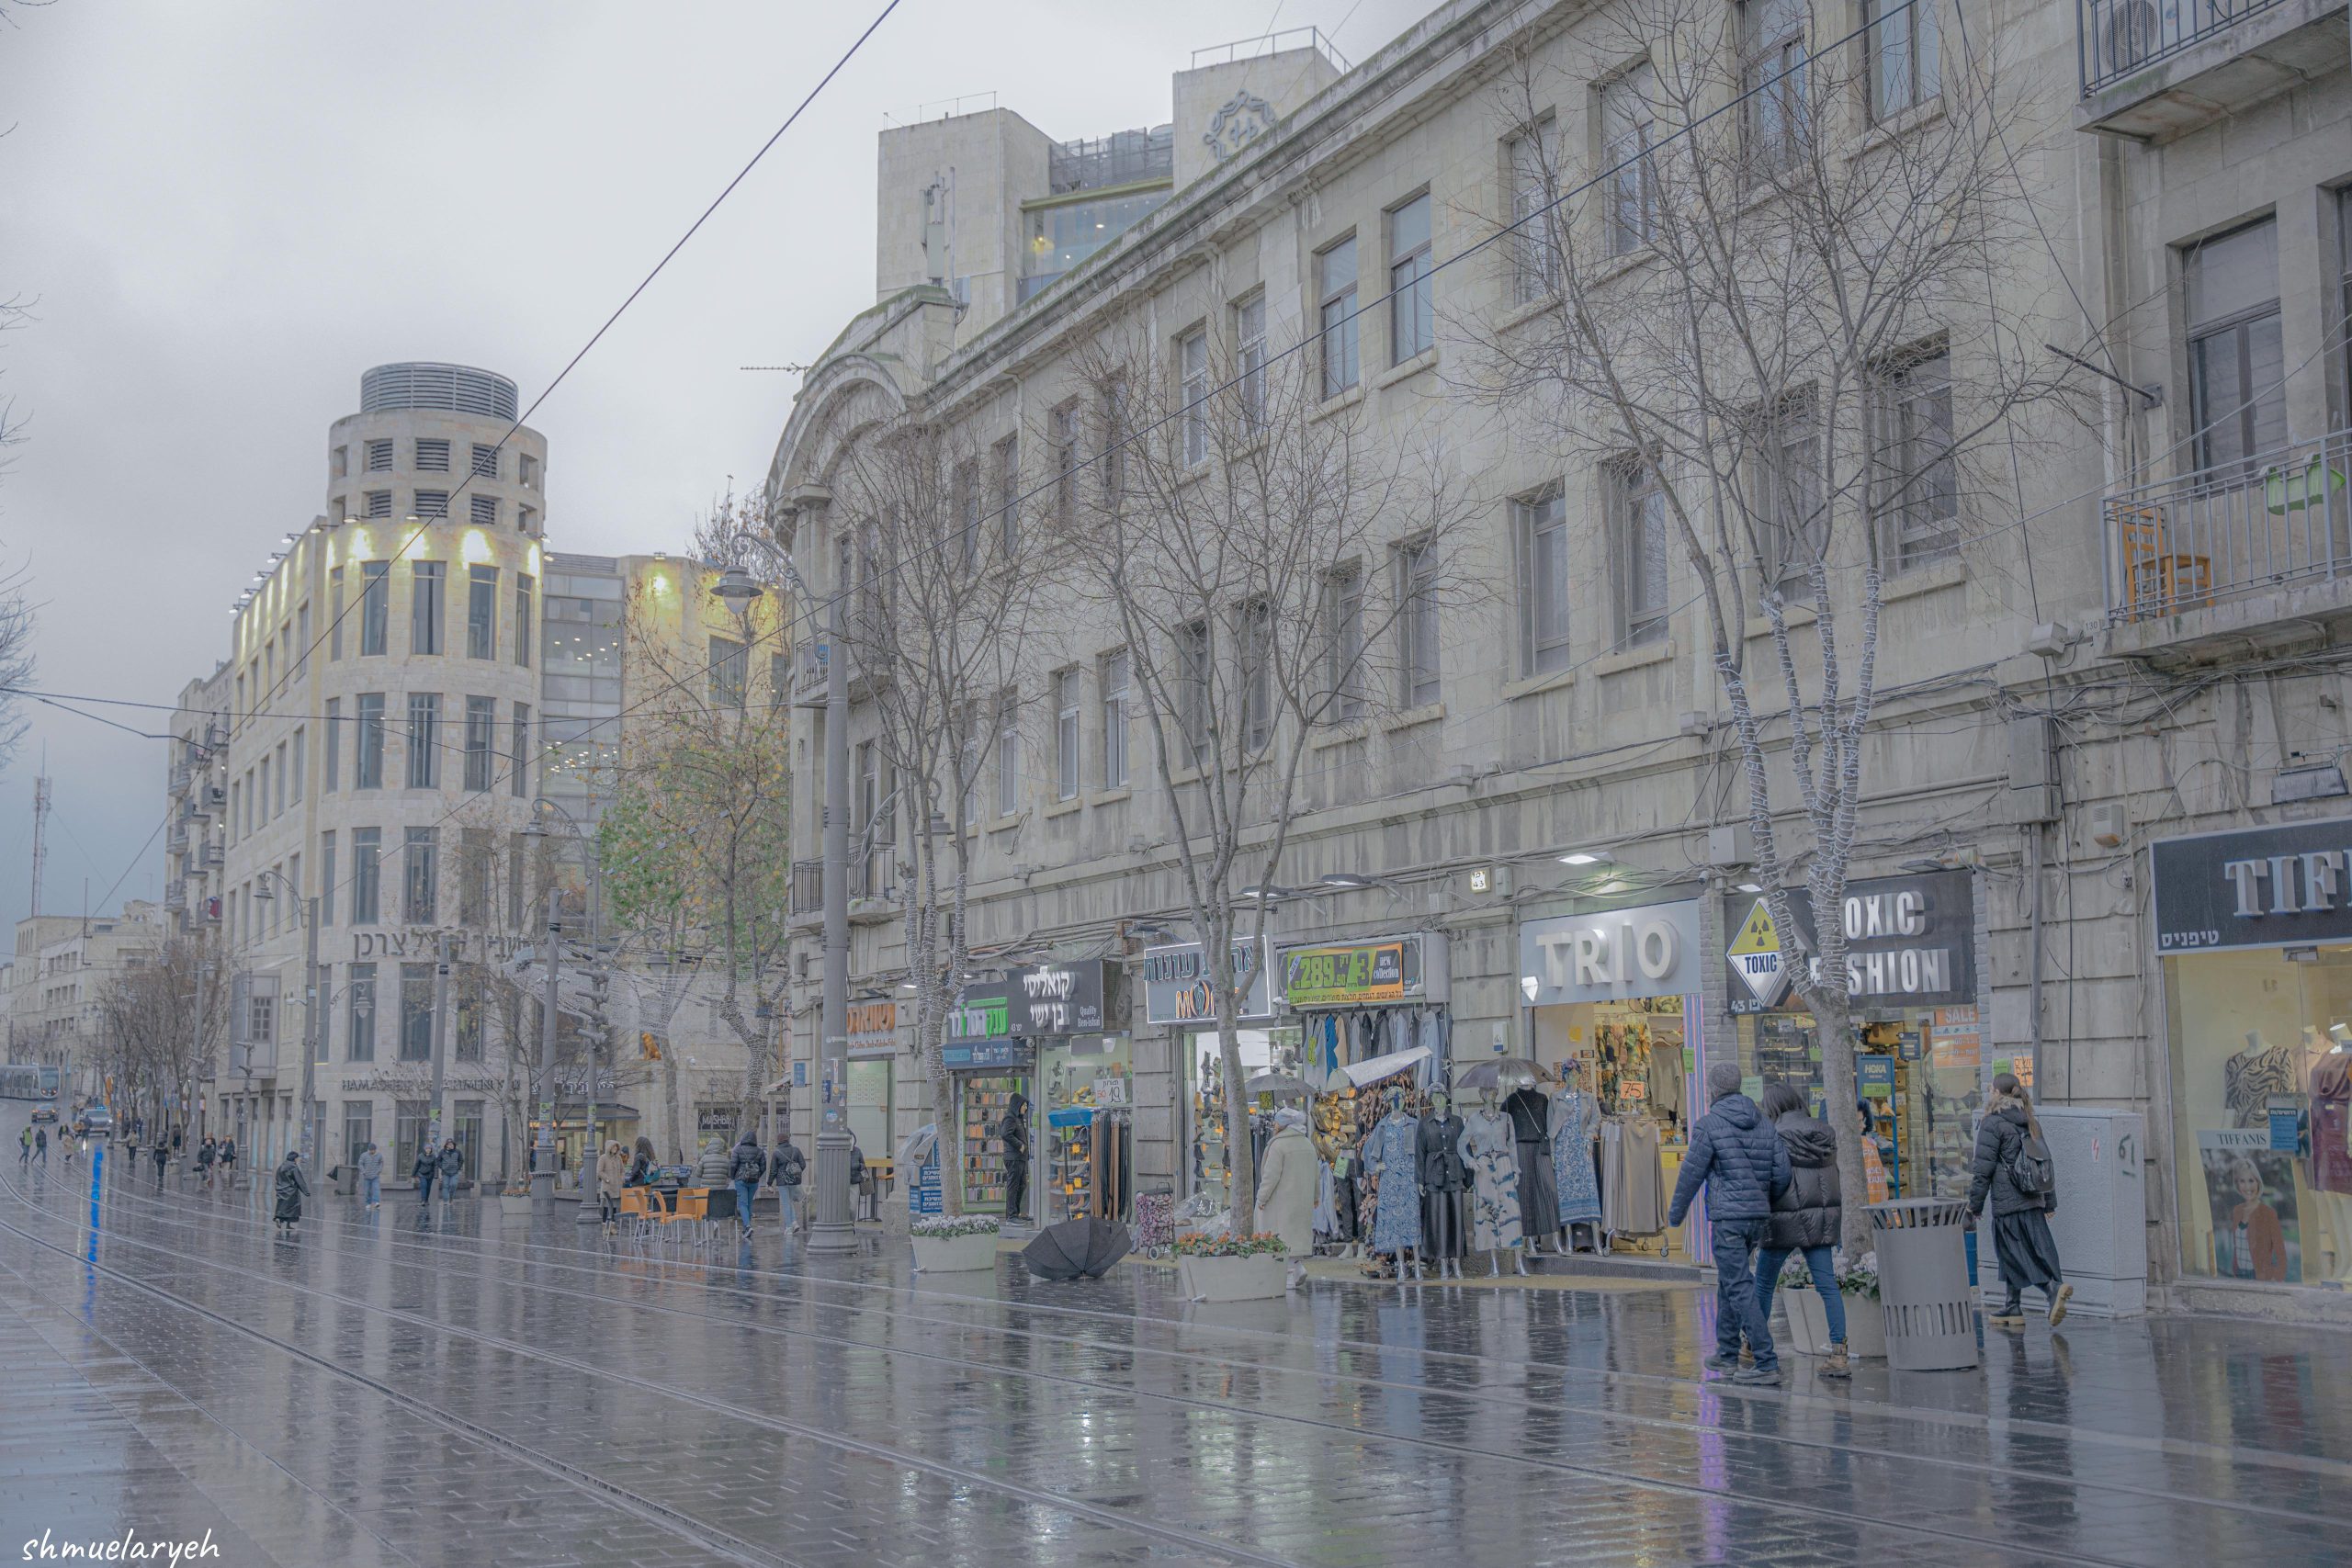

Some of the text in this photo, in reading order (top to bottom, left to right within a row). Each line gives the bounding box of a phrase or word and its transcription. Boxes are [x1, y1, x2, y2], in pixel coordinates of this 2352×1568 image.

[2224, 850, 2352, 917] TIF
[1845, 891, 1922, 941] OXIC
[2161, 930, 2220, 947] טיפניס
[1379, 955, 1391, 967] new
[1535, 920, 1679, 988] TRIO
[1143, 953, 1195, 982] עונות
[1745, 953, 1778, 974] TOXIC
[1373, 968, 1399, 980] collection
[1809, 949, 1944, 996] FSHION
[1023, 966, 1074, 1002] קואליטי
[1080, 1006, 1096, 1018] Quality
[1731, 999, 1745, 1012] 43
[1029, 1001, 1069, 1033] בן ישי
[1945, 1007, 1976, 1023] SALE
[1864, 1064, 1887, 1074] HOKA
[1623, 1082, 1642, 1099] 75
[2216, 1133, 2267, 1145] TIFFANIS
